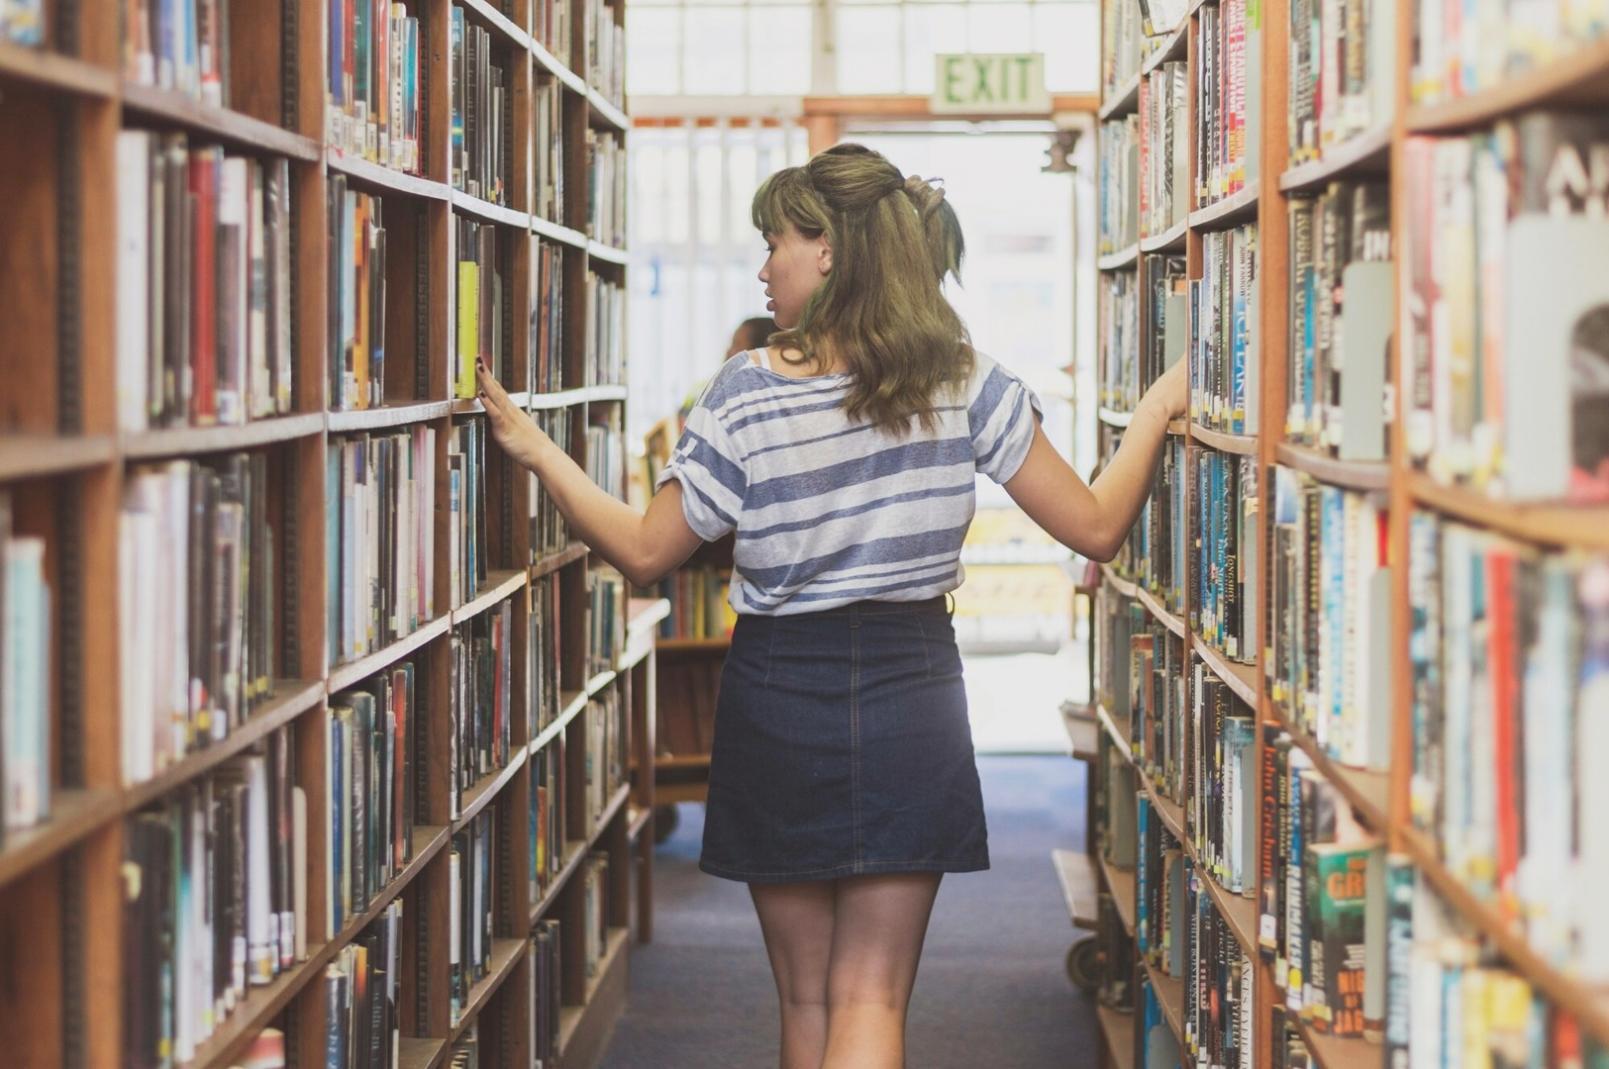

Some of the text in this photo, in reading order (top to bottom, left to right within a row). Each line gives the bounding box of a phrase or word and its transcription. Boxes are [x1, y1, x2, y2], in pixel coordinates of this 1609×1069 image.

[944, 56, 1034, 103] EXIT
[1217, 567, 1225, 592] Start
[1264, 746, 1277, 879] John Grisham
[1279, 776, 1287, 858] JOHN GRISHAM
[1286, 863, 1302, 970] RAINMAKER
